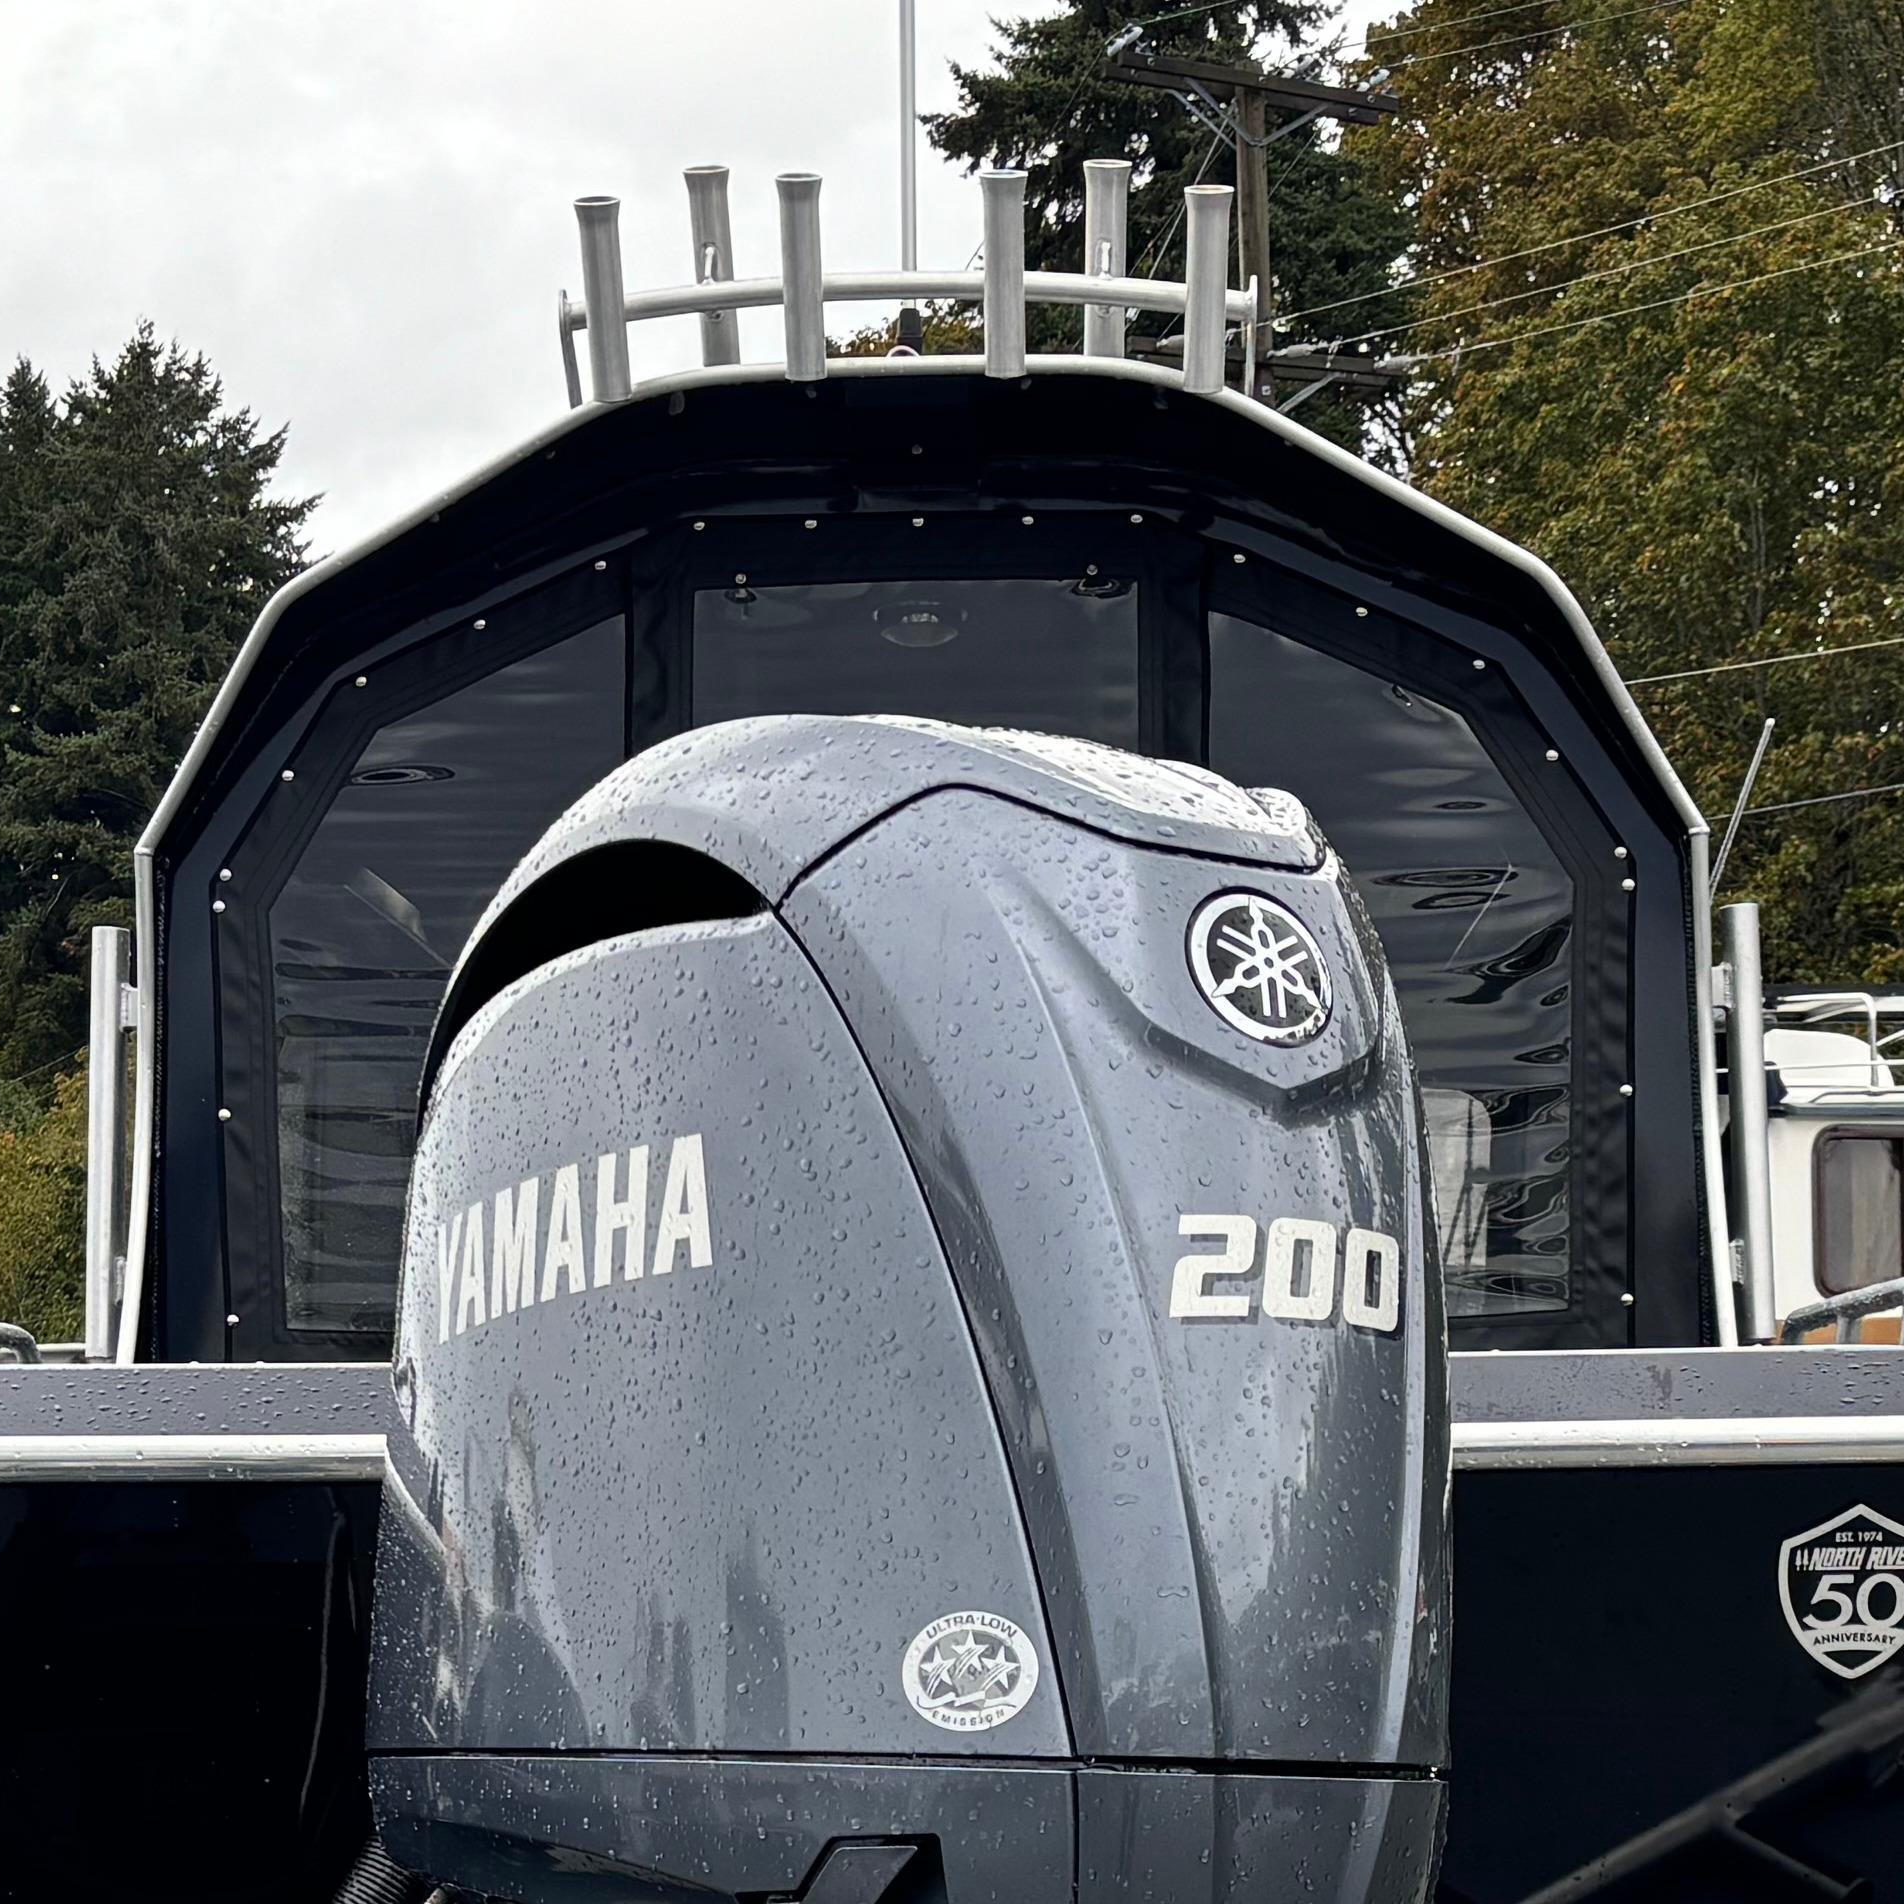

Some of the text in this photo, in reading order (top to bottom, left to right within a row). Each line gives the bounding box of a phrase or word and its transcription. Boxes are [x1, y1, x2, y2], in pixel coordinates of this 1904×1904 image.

[437, 1133, 713, 1344] YAMAHA
[1169, 1214, 1399, 1333] 200
[1857, 1531, 1883, 1543] 1974
[1808, 1546, 1867, 1571] NORTH
[1813, 1632, 1896, 1646] ANNIVERSARY
[931, 1708, 1005, 1726] EMISSION
